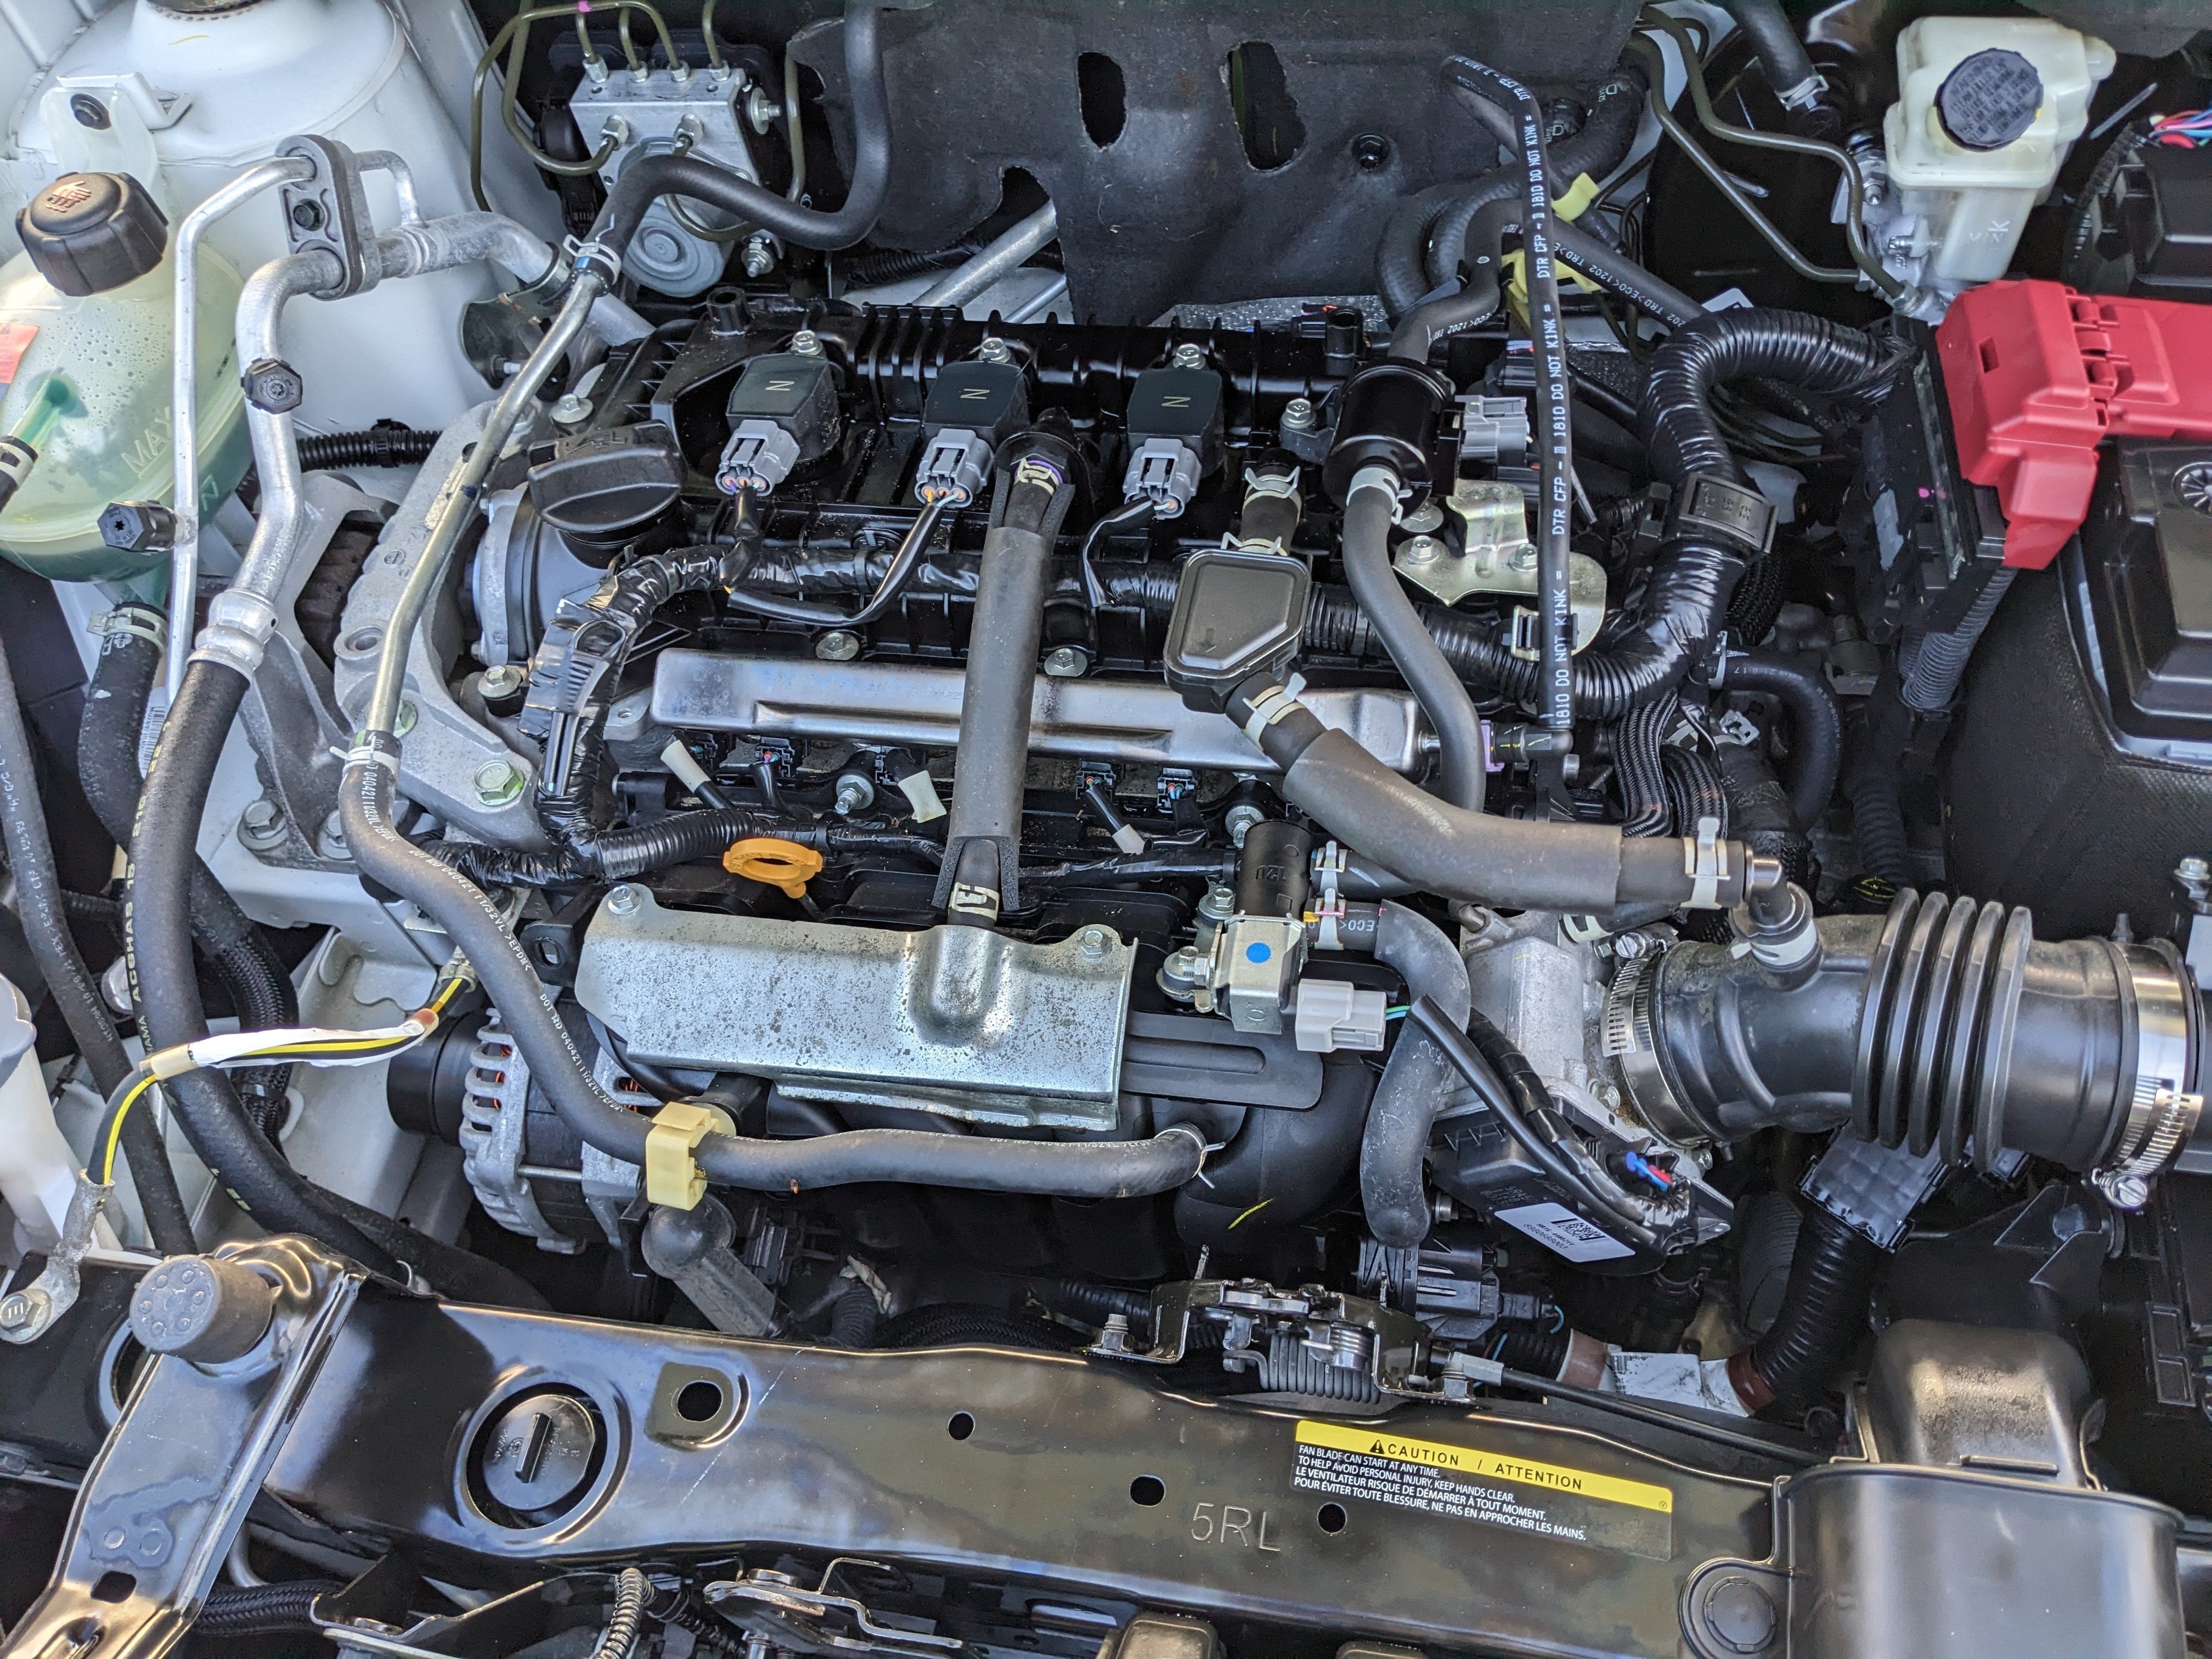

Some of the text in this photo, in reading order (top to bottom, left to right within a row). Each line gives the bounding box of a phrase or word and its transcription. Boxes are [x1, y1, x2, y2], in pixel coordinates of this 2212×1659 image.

[1514, 87, 1531, 101] DTR
[1523, 125, 1538, 146] KINK
[1527, 150, 1541, 167] NOT
[1530, 169, 1543, 182] DO
[1531, 185, 1545, 207] 1810
[1534, 234, 1548, 253] CFP
[1536, 257, 1551, 279] DTR
[1543, 318, 1559, 348] KINK
[1547, 355, 1562, 377] NOT
[766, 380, 794, 392] N
[960, 387, 990, 400] N
[1550, 383, 1564, 400] DO
[1161, 396, 1192, 408] N
[1553, 407, 1566, 437] 1810
[1553, 477, 1567, 502] CFP
[1551, 509, 1566, 535] DTR
[1555, 589, 1567, 628] KINK
[1555, 632, 1568, 663] NOT
[1555, 669, 1569, 687] DO
[1555, 693, 1570, 725] 1810
[1299, 1444, 1441, 1478] FAN BLADE CAN START AT ANY TIME.
[1388, 1443, 1459, 1466] CAUTION
[1494, 1463, 1582, 1491] ATTENTION
[1298, 1455, 1516, 1503] TO HELP AVOID PERSONAL INJURY, KEEP HANDS CLEAR.
[1295, 1466, 1547, 1521] LE VENTILATEUR RISQUE DE DÉMARRER À TOUT MOMENT.
[1294, 1476, 1587, 1541] POUR ÉVITER TOUTE BLESSURE, NE PAS EN APPROCHER LES MAINS.
[1190, 1501, 1282, 1553] 5RL
